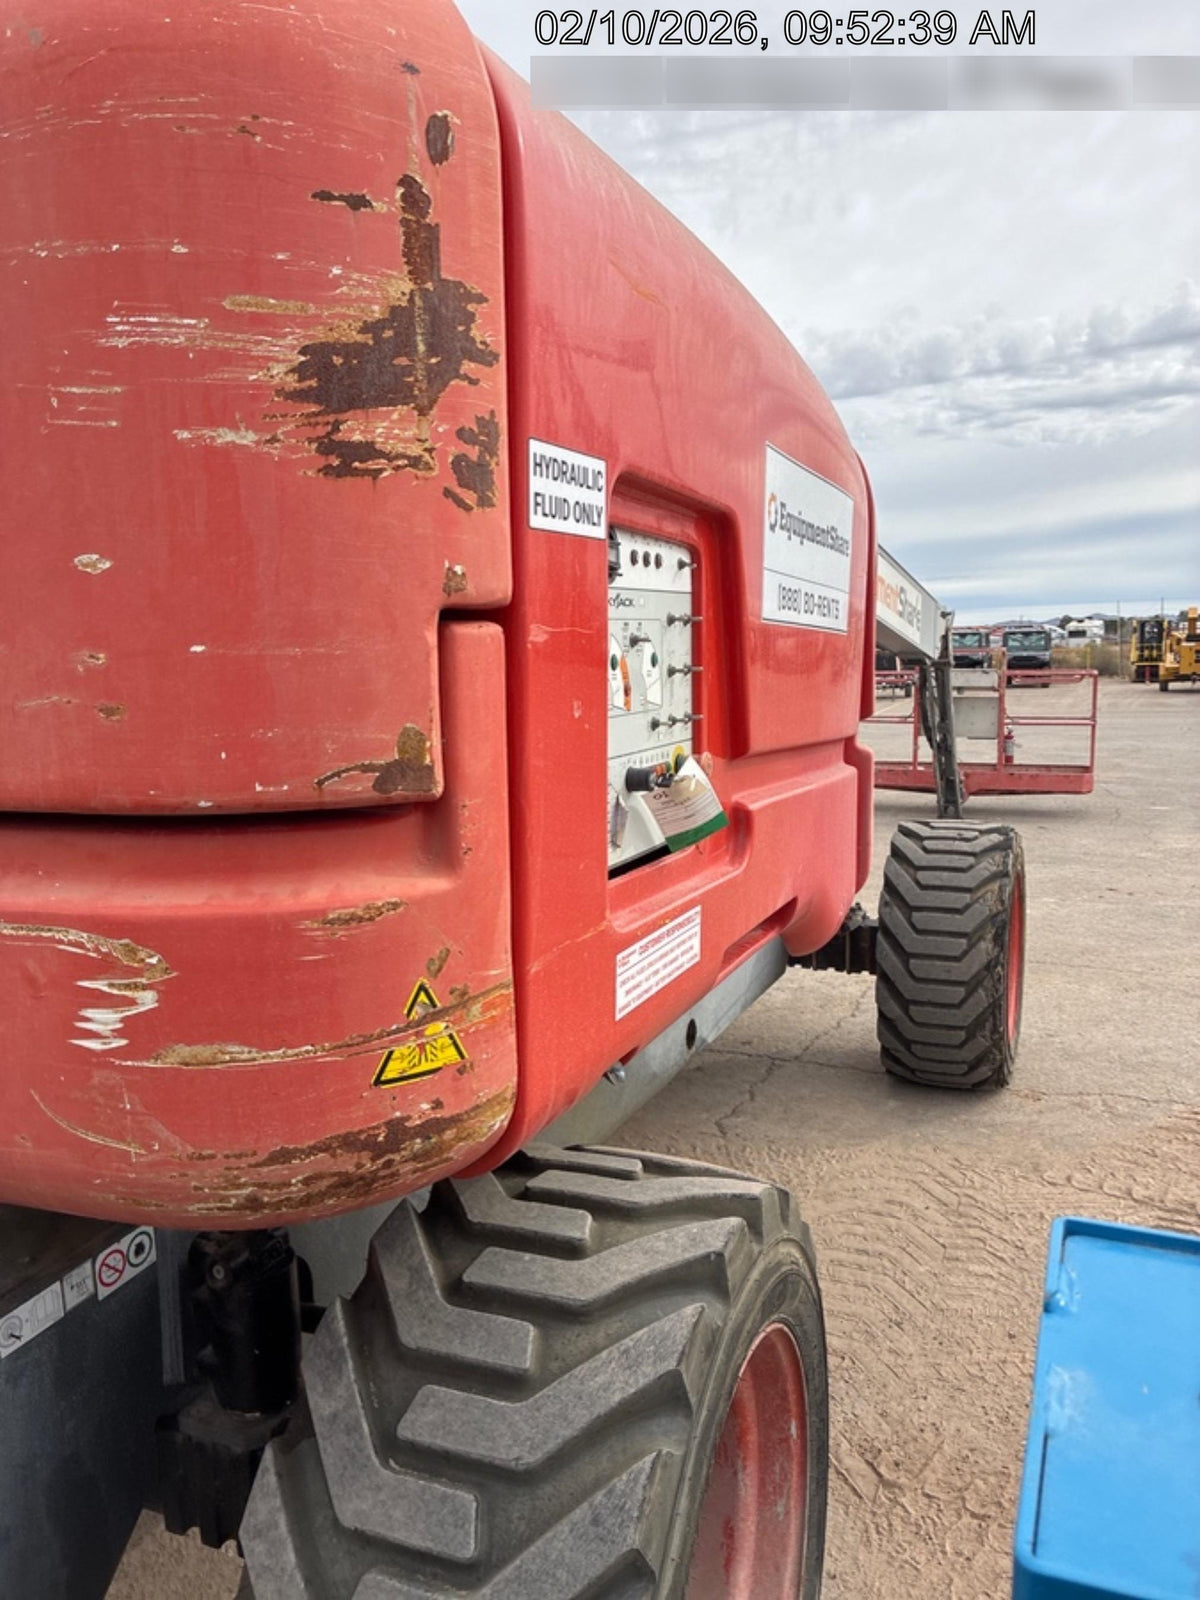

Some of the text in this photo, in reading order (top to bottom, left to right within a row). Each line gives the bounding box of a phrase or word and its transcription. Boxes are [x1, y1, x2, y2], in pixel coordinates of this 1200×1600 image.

[532, 452, 604, 493] HYDRAULIC
[533, 492, 604, 528] FLUID ONLY
[779, 501, 850, 558] EquipmentShare
[777, 582, 802, 616] (888)
